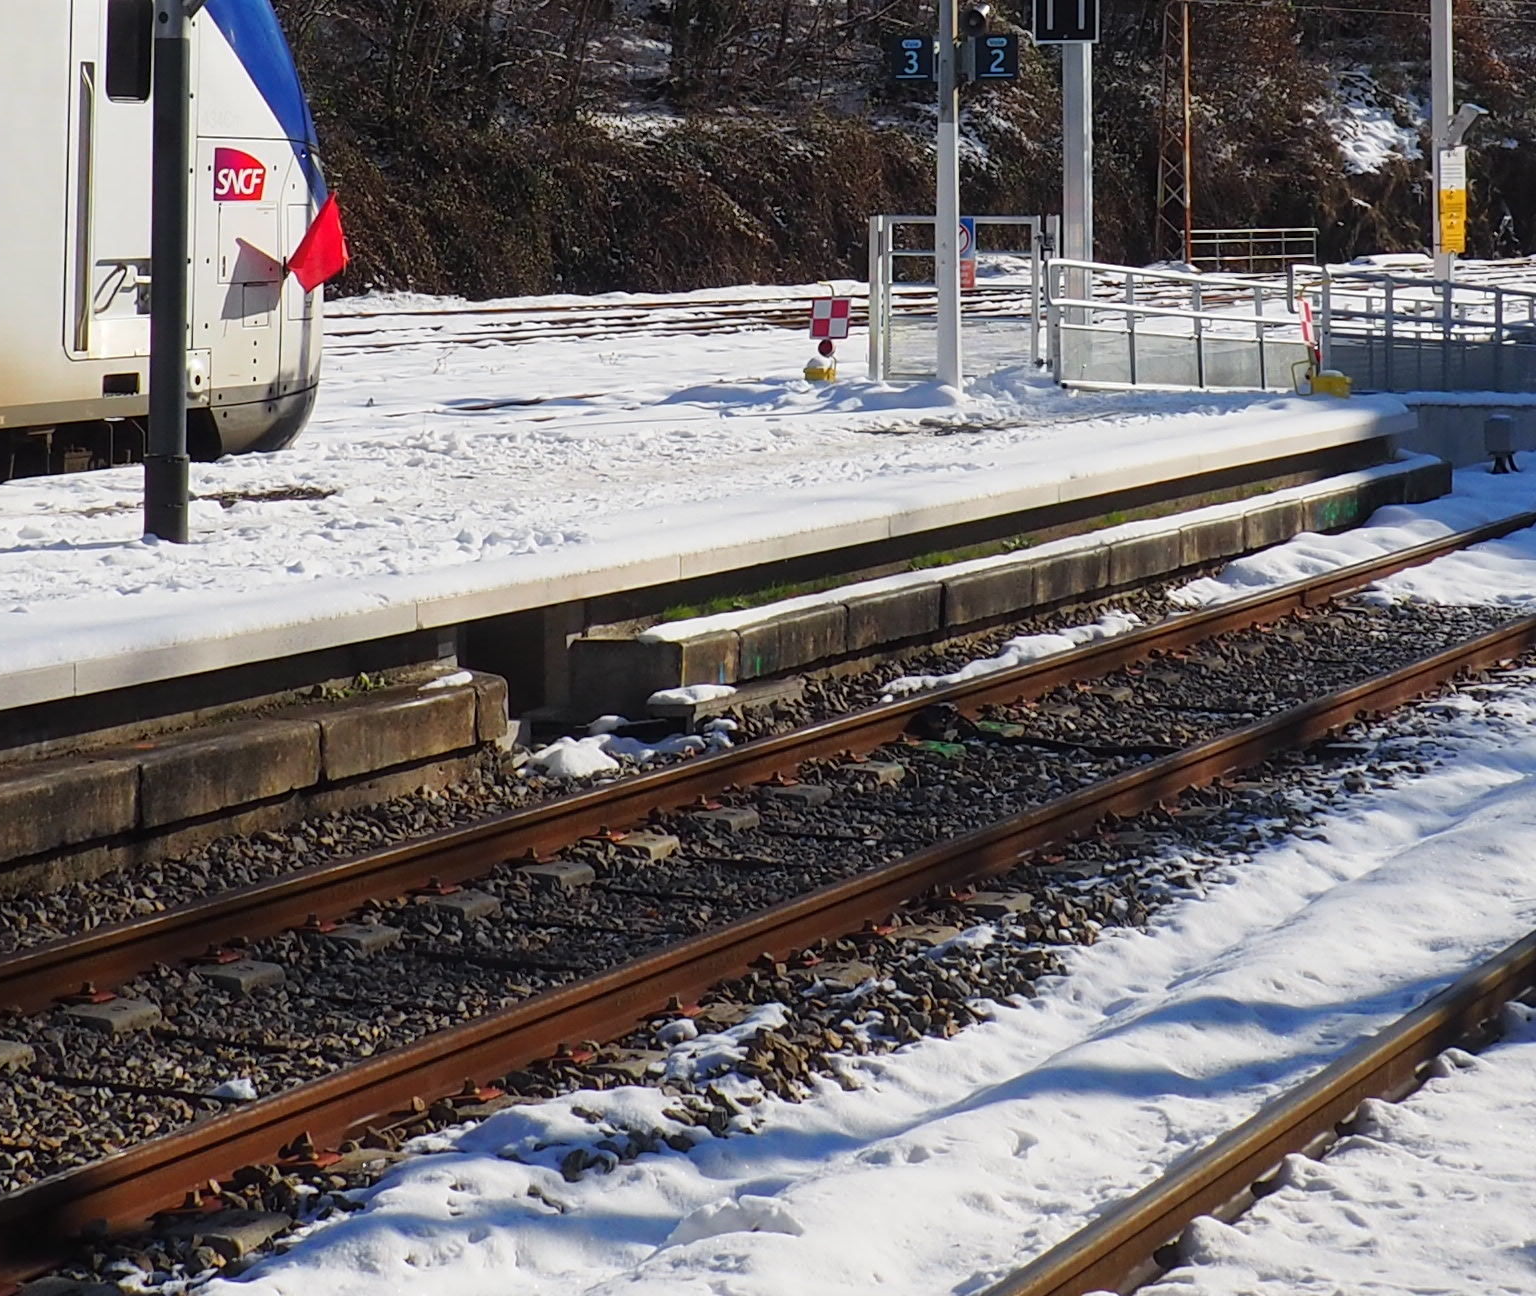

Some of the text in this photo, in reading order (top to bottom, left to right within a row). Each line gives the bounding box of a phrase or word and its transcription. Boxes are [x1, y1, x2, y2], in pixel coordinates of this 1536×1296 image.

[903, 50, 919, 74] 3
[989, 48, 1005, 73] 2
[215, 168, 264, 195] SNCF
